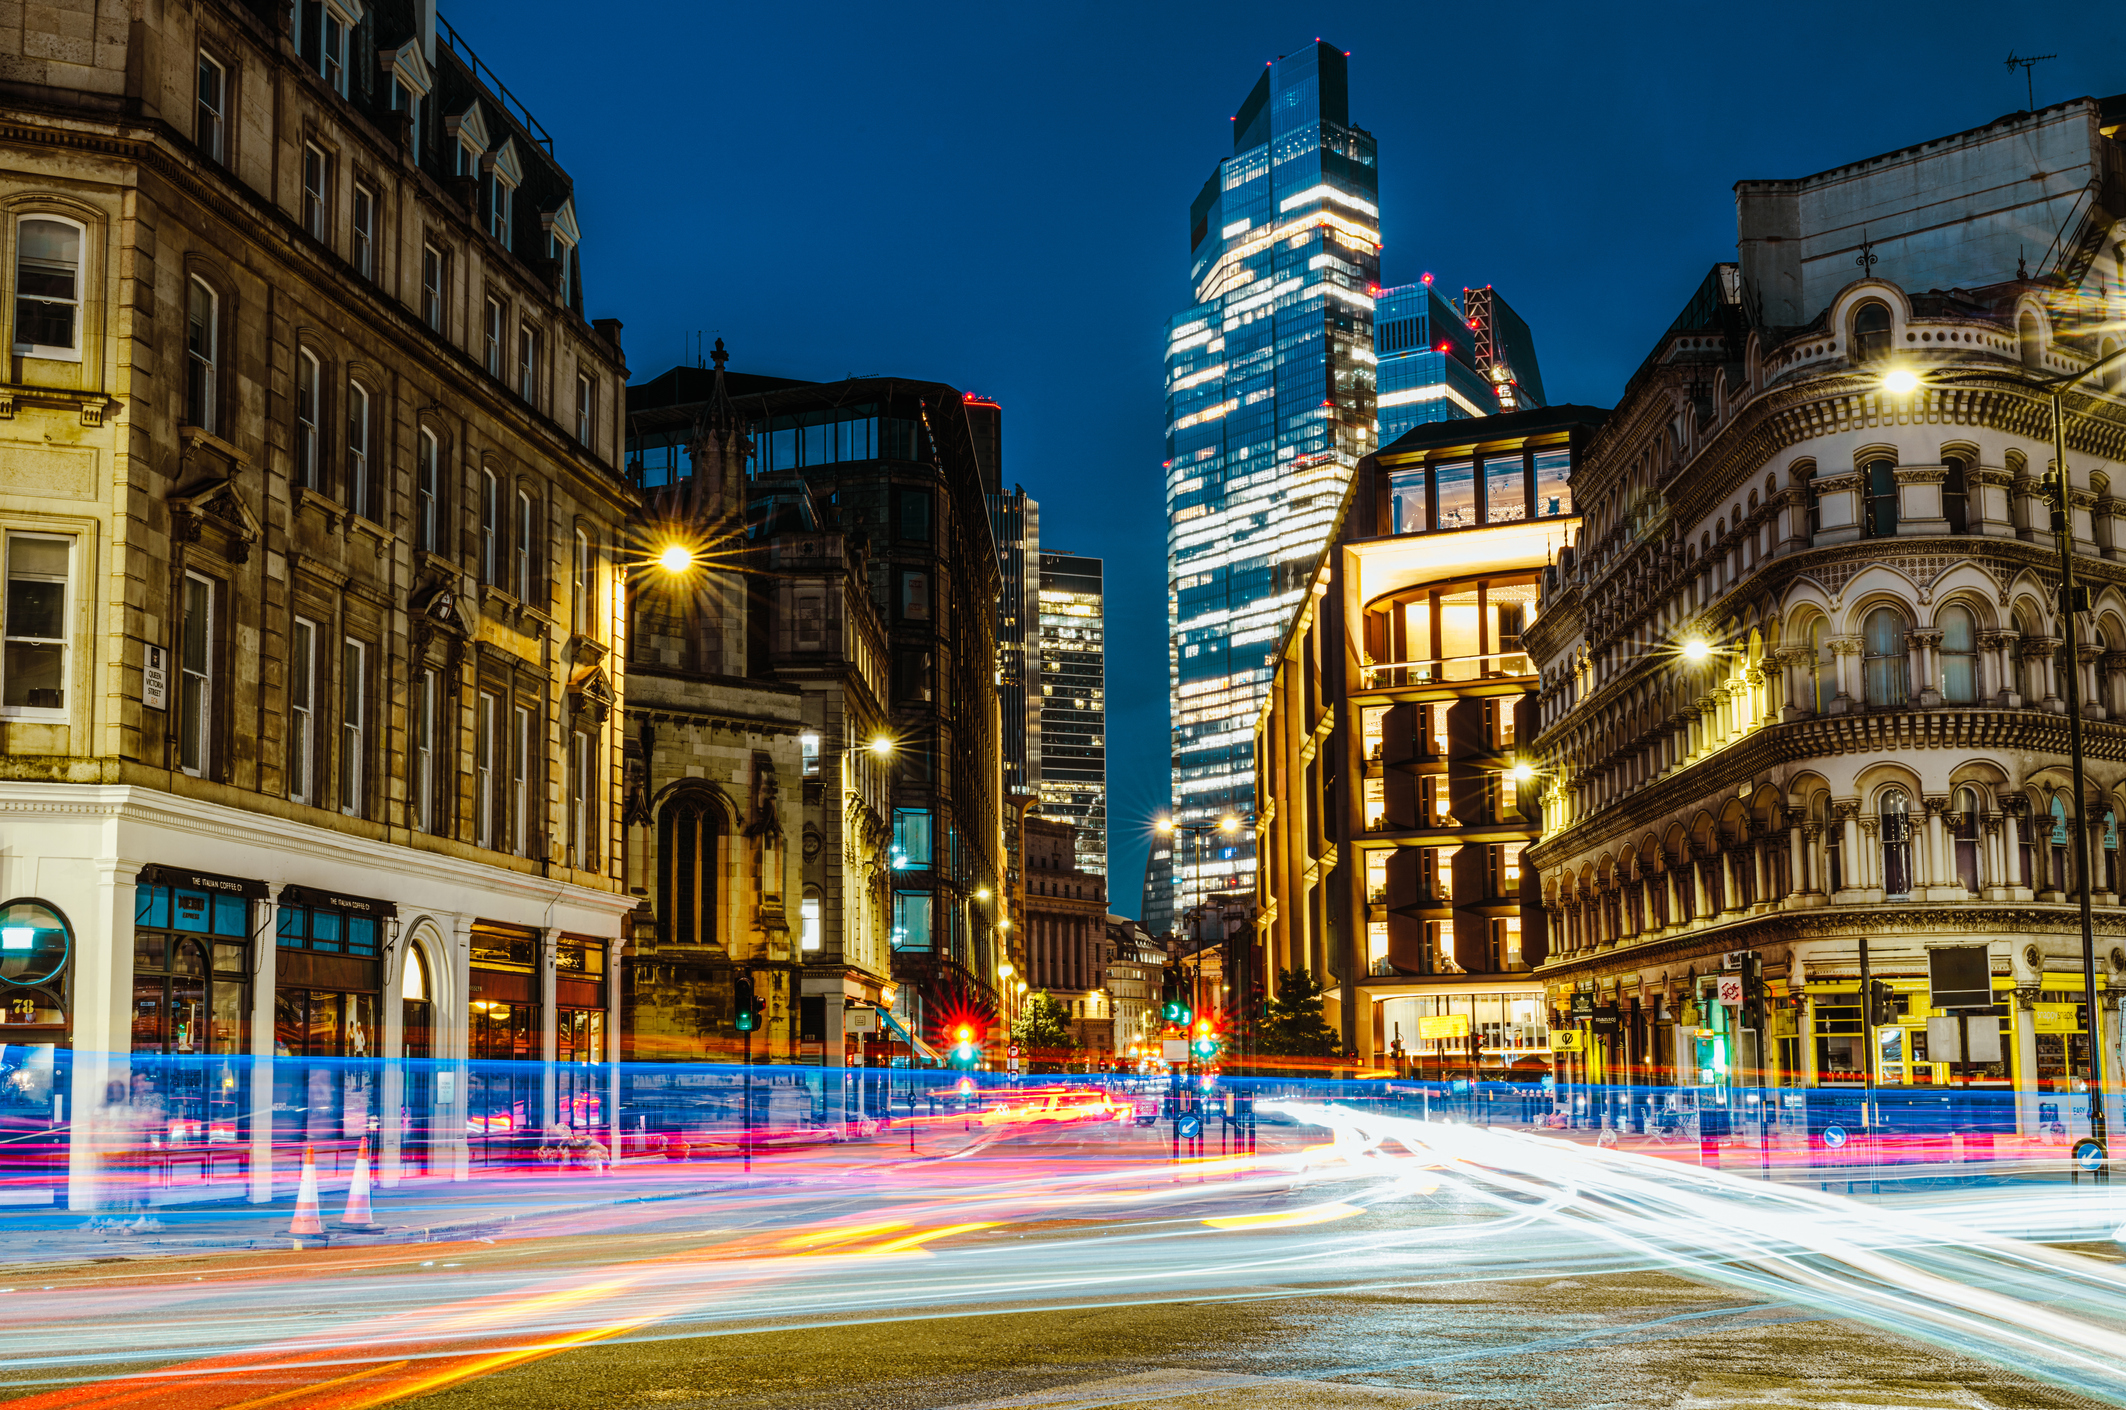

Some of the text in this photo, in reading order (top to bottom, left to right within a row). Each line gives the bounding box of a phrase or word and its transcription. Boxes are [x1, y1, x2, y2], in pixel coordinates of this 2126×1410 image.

[148, 670, 162, 680] QUEEN
[145, 678, 164, 690] VICTORIA
[147, 687, 162, 698] STREET
[192, 876, 201, 886] THE
[201, 878, 219, 888] ITALIAN
[219, 881, 237, 891] COFFEE
[330, 897, 338, 906] THE
[338, 898, 352, 907] ITALIAN
[351, 901, 366, 910] COFFEE
[12, 998, 35, 1014] 78
[2073, 1107, 2085, 1115] EASY
